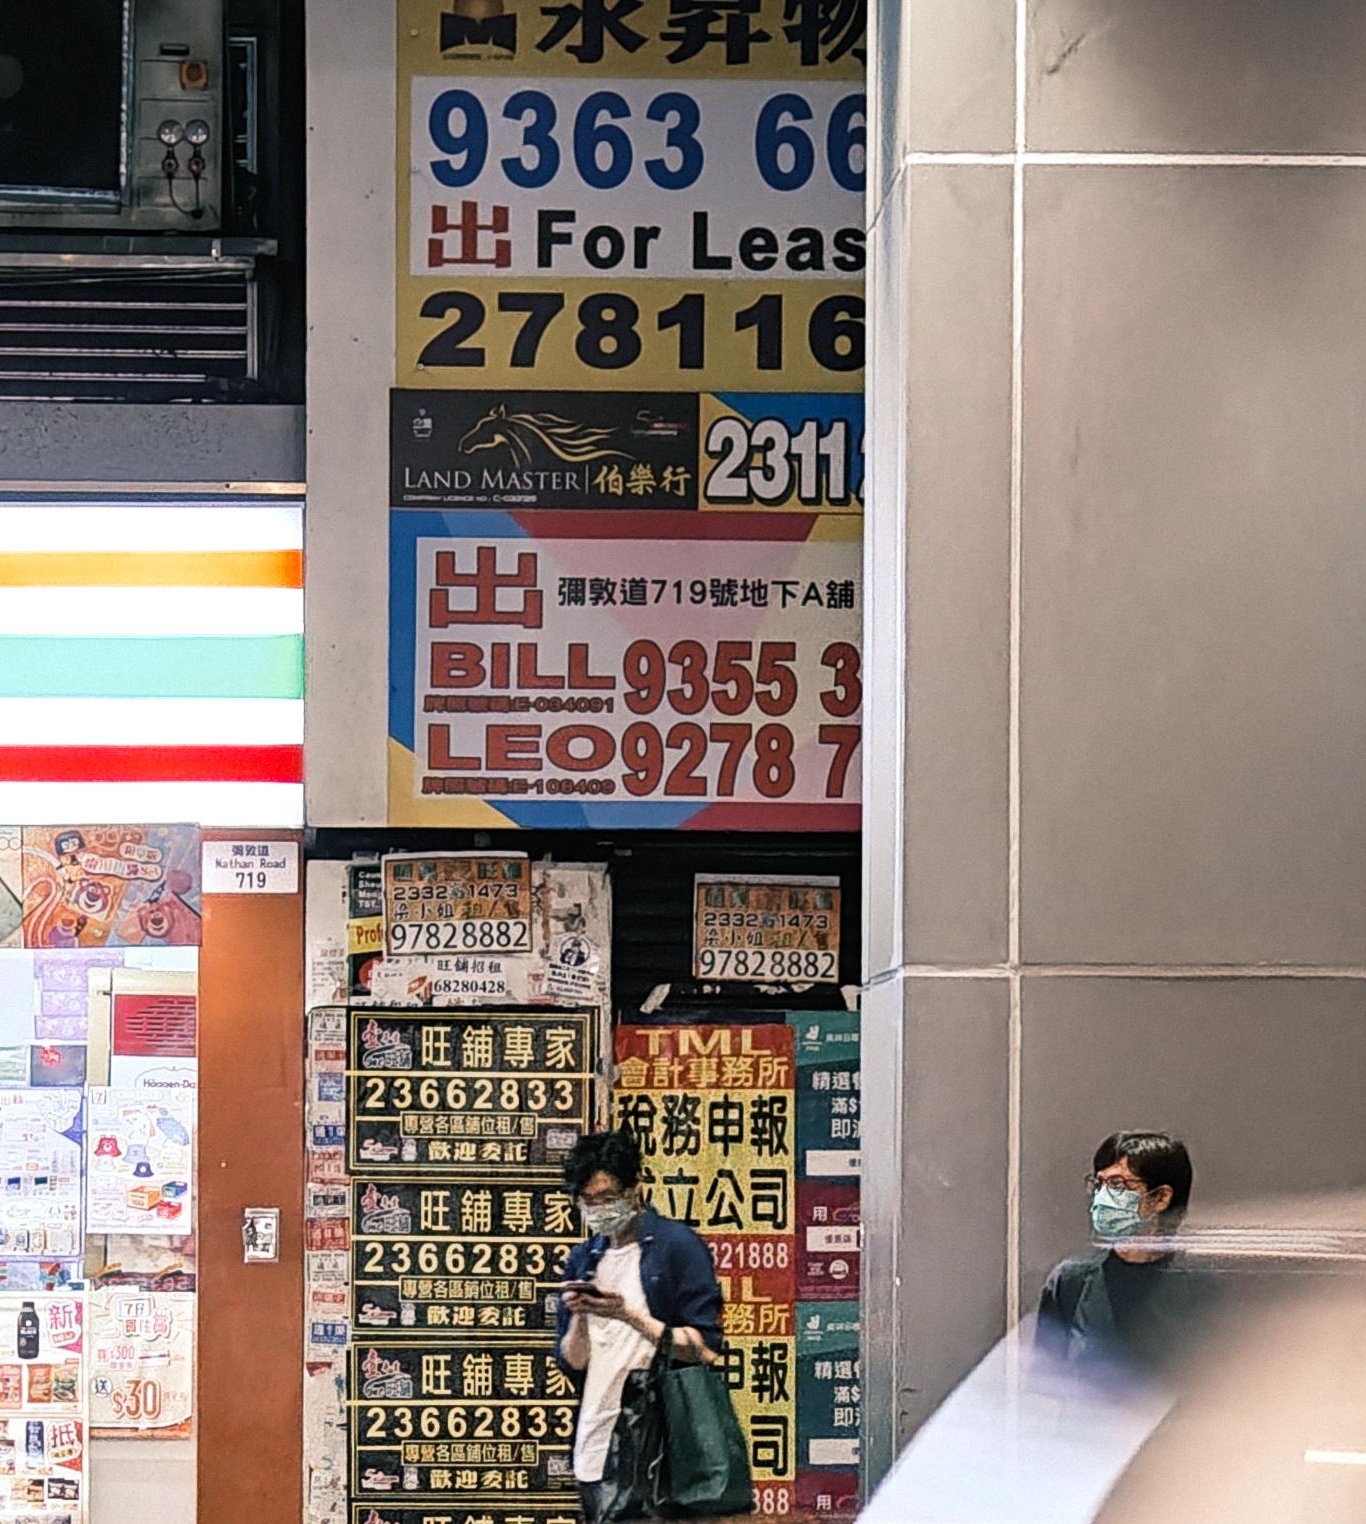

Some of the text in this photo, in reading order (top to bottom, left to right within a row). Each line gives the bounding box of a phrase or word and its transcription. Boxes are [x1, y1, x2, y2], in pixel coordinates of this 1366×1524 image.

[428, 88, 705, 190] 9363
[427, 200, 512, 269] 出
[537, 209, 662, 270] For
[419, 290, 866, 372] 278116
[706, 416, 849, 504] 2311
[403, 467, 472, 490] LAND
[482, 468, 580, 491] MASTER
[429, 545, 544, 630] 出
[430, 639, 862, 718] BILL 9355 3
[427, 721, 862, 798] LEO 9278 7
[215, 858, 286, 870] Nathan Road
[235, 871, 267, 889] 719
[393, 883, 520, 900] 2332 1473
[703, 911, 829, 930] 2332 1473
[433, 979, 506, 994] 68280428
[420, 1025, 577, 1069] 旺舖專家
[635, 1028, 772, 1056] TML
[619, 1055, 789, 1088] 會計事務所
[364, 1077, 574, 1111] 23662833
[617, 1092, 789, 1157] 稅務申報
[419, 1190, 575, 1234] 旺舖專家
[639, 1166, 788, 1231] 立公司
[363, 1242, 571, 1275] 23662833
[48, 1303, 73, 1331] 新
[112, 1379, 158, 1418] $30
[50, 1423, 75, 1448] 抵
[365, 1406, 574, 1438] 23662833
[749, 1414, 789, 1477] 司
